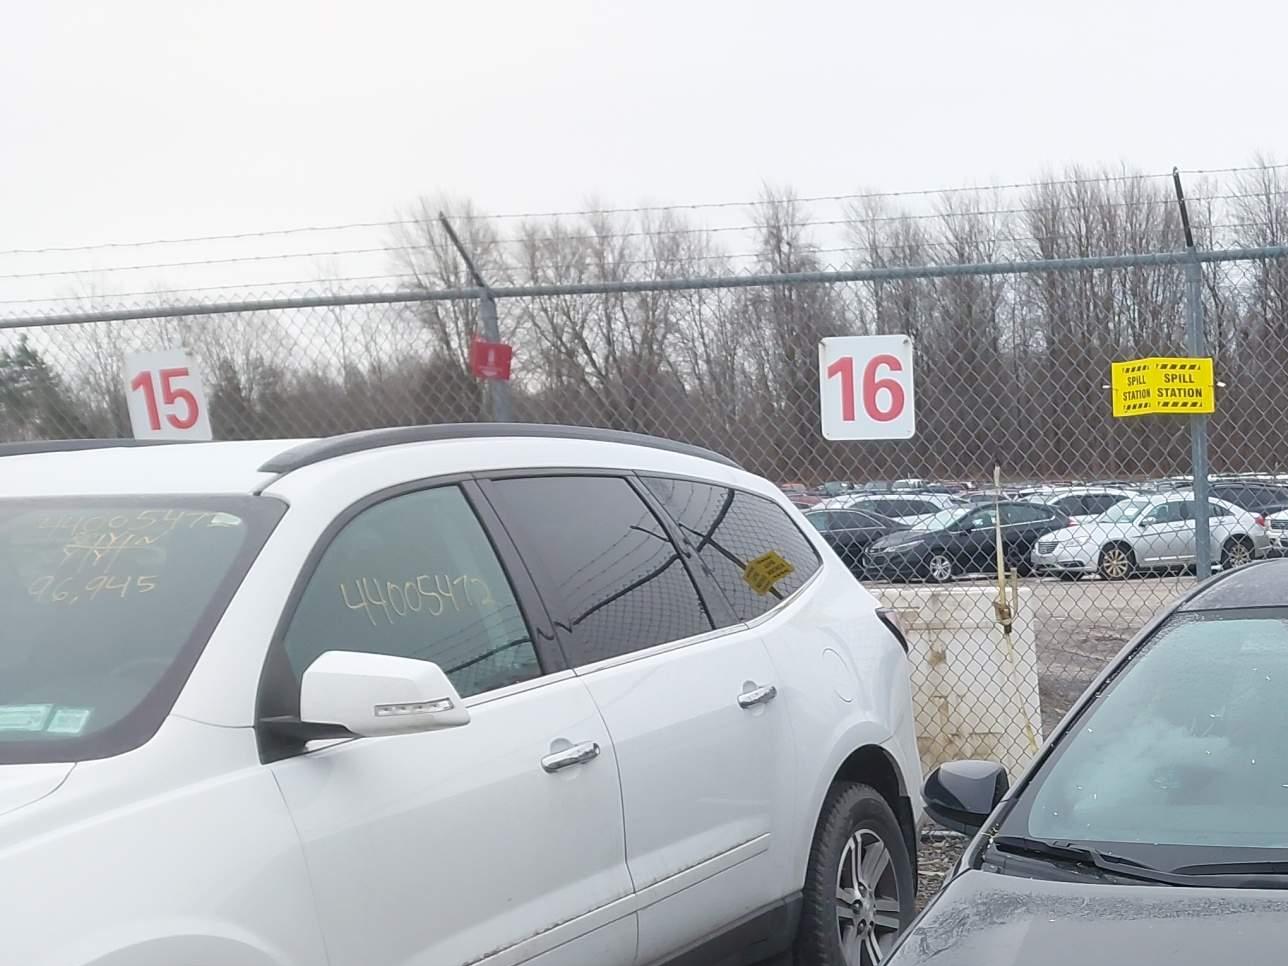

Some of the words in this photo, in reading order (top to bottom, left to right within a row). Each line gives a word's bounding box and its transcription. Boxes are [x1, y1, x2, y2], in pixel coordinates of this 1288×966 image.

[1127, 375, 1146, 387] SPILL
[1163, 373, 1196, 384] SPILL
[827, 354, 905, 422] 16
[1157, 387, 1203, 398] STATION
[131, 367, 199, 430] 15
[1122, 388, 1151, 402] STATION
